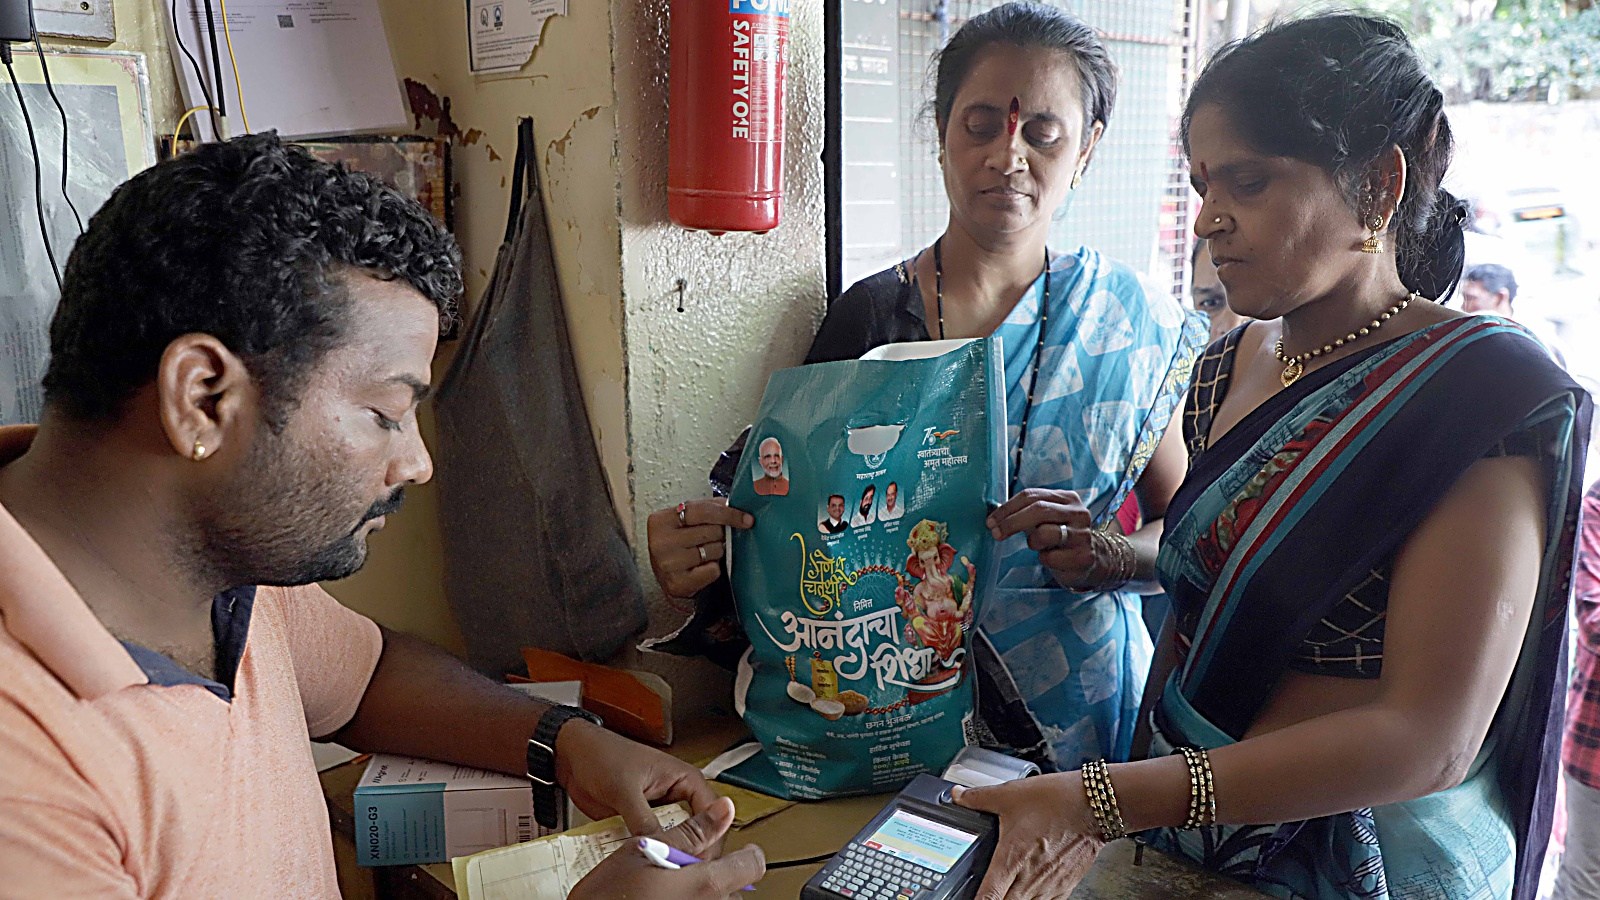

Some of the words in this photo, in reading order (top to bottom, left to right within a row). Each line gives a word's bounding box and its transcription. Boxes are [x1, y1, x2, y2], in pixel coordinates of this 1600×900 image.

[732, 20, 750, 99] SAFETY
[917, 447, 950, 459] स्वातंत्र्याचा
[923, 458, 941, 471] अमृत
[941, 454, 968, 467] महोत्सव
[755, 606, 902, 681] आनंदाचा
[869, 642, 967, 691] शिधा
[865, 720, 885, 730] छगन
[886, 713, 913, 728] भुजबळ
[368, 806, 380, 860] XN020-G3
